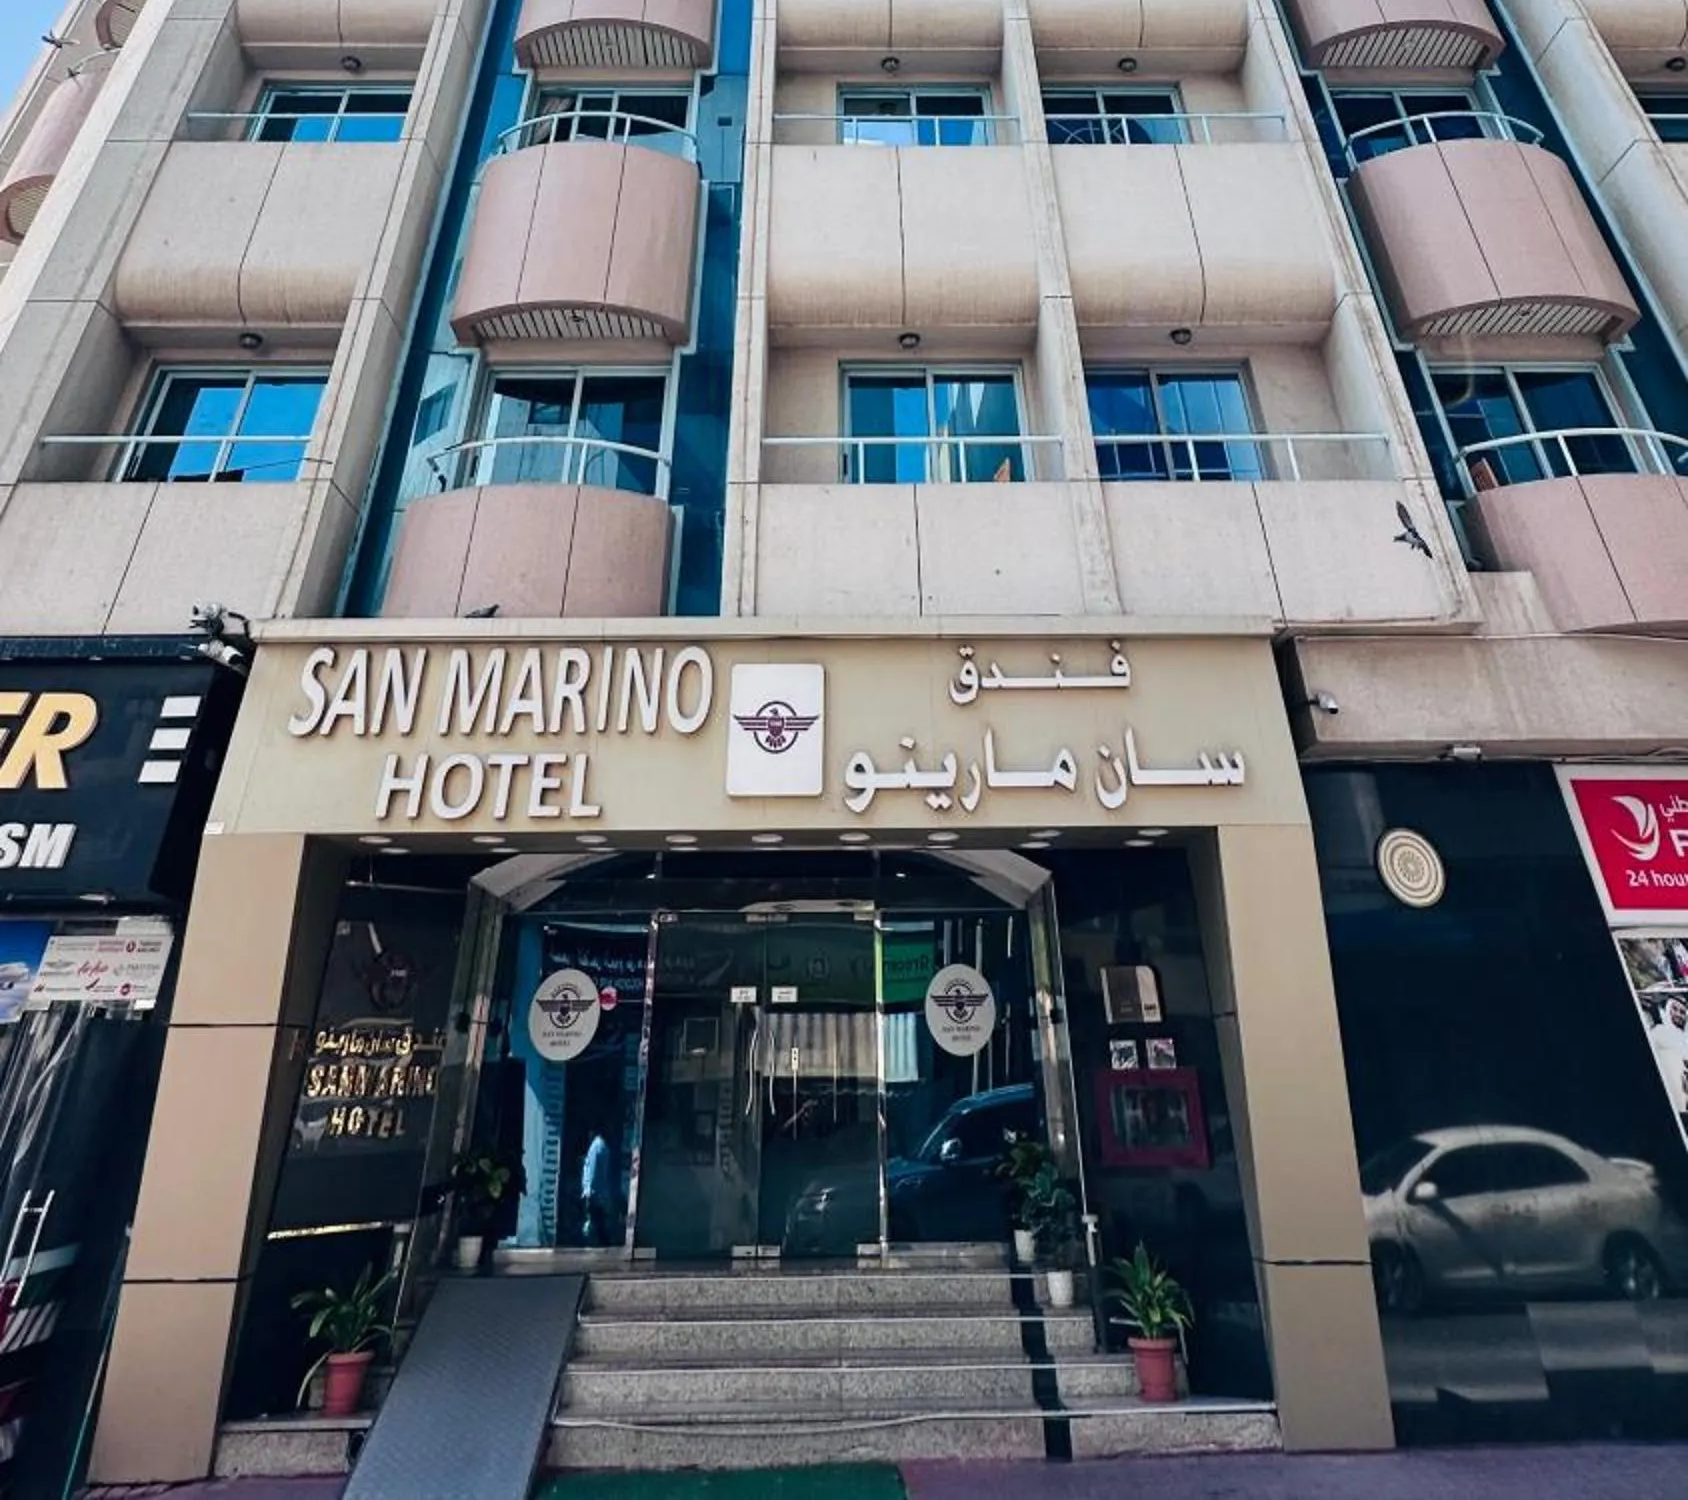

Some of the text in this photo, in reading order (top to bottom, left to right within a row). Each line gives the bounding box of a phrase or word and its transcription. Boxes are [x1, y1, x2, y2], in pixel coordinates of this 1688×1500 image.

[288, 645, 713, 736] SAN MARINO
[948, 638, 1132, 705] فندق
[375, 752, 602, 820] HOTEL
[844, 726, 1245, 813] سان مارينو
[1625, 869, 1649, 887] 24
[328, 1105, 405, 1137] HOTEL
